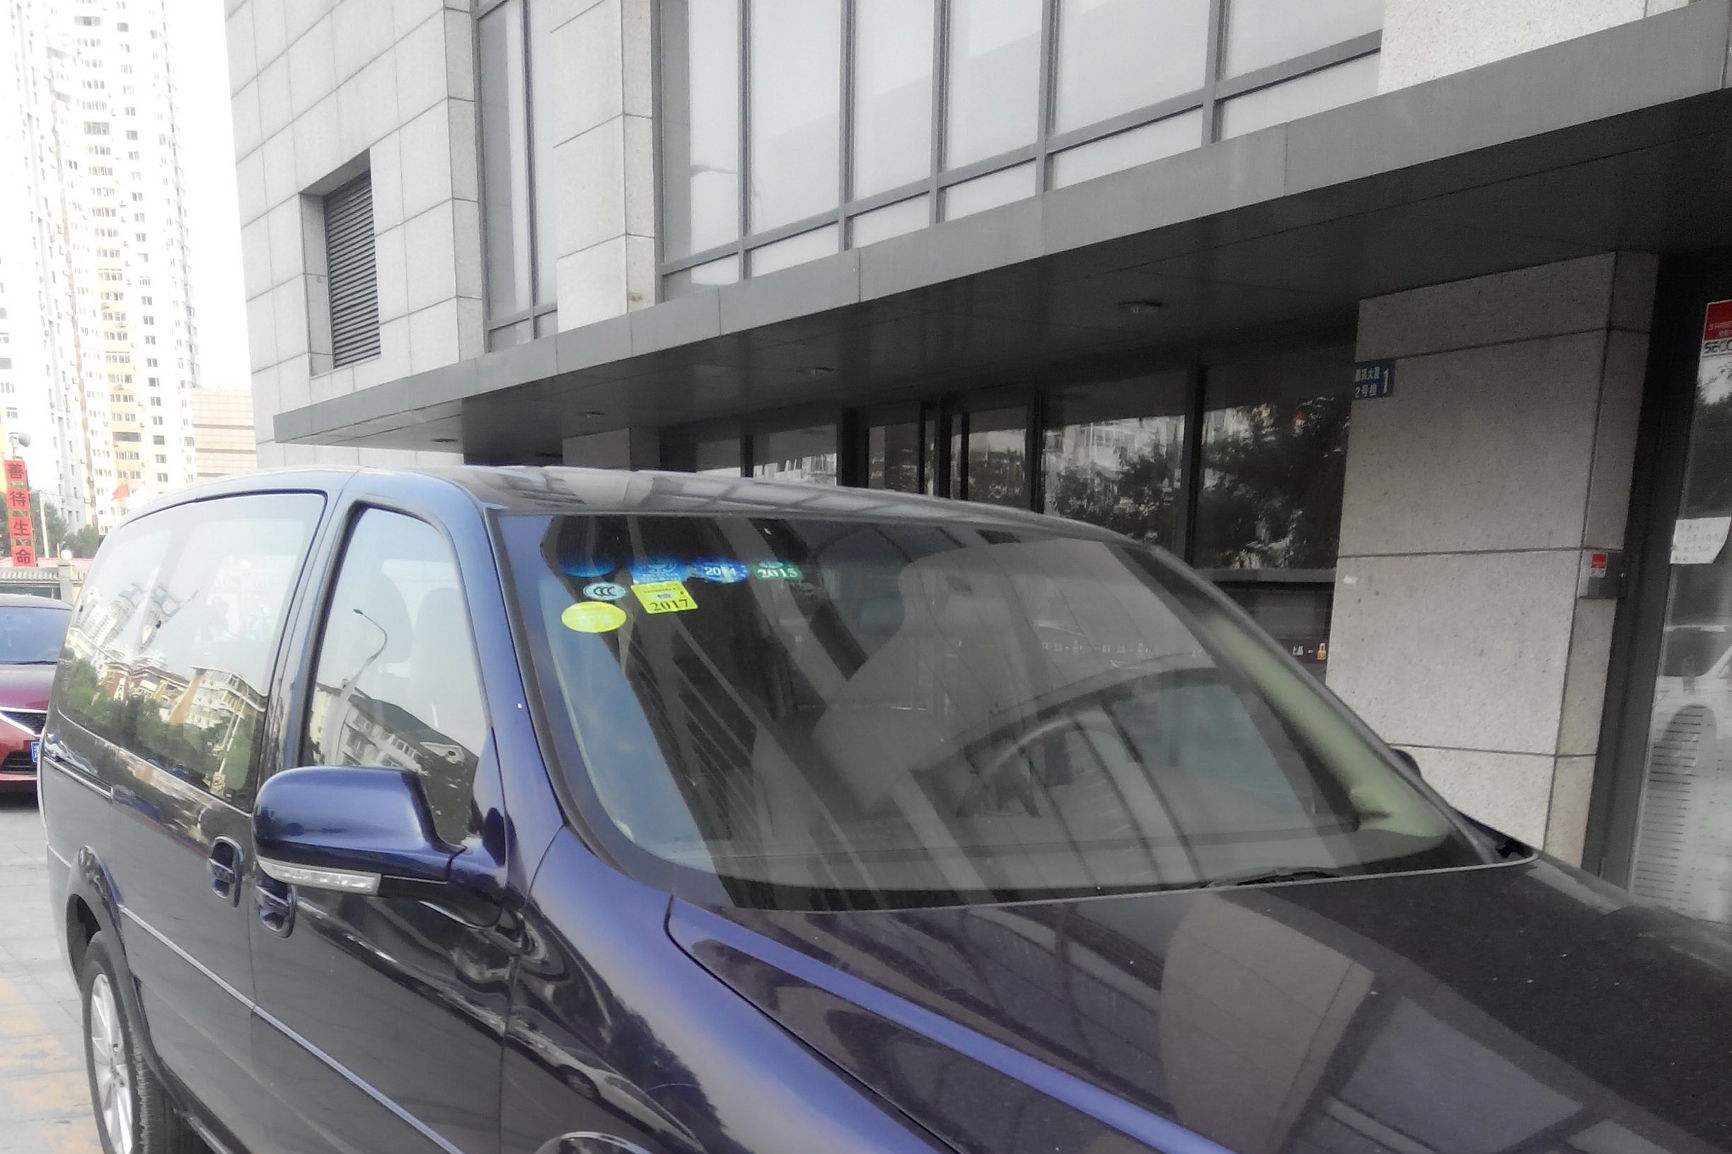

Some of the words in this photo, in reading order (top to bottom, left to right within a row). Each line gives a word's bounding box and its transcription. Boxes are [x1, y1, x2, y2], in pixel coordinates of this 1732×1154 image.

[8, 463, 32, 565] 善待生命
[757, 567, 798, 578] 2015
[593, 586, 616, 597] CCC
[649, 598, 690, 613] 2017
